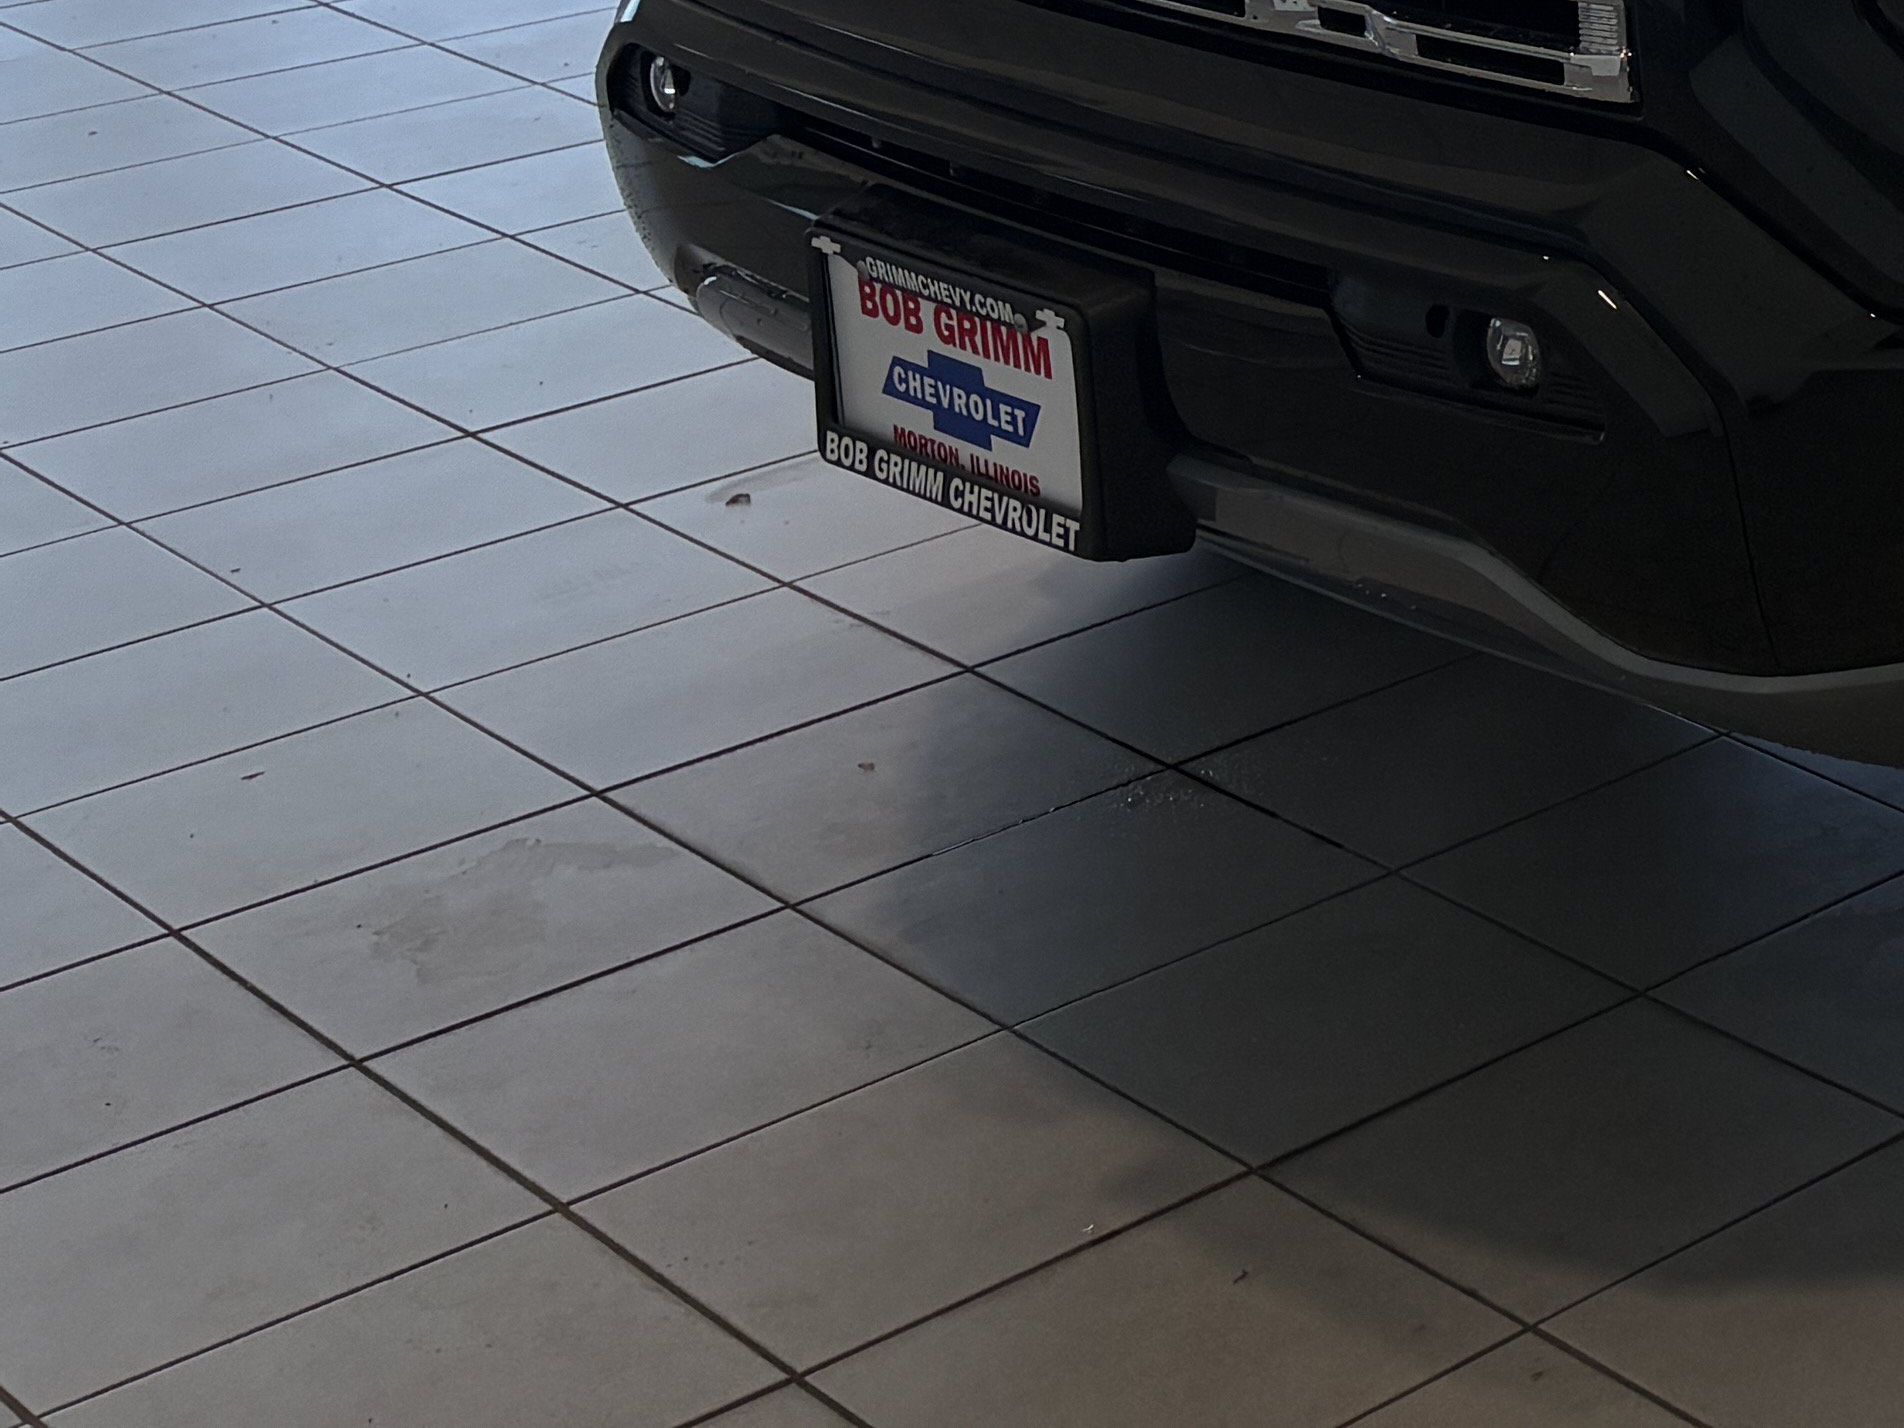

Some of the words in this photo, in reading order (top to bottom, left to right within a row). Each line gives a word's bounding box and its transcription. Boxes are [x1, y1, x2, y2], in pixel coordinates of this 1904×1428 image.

[865, 256, 1015, 325] GRIMMCHEVY.COM
[858, 279, 924, 335] BOB
[934, 304, 1053, 379] GRIMM
[892, 365, 1027, 437] CHEVROLET
[825, 430, 868, 473] BOB
[874, 448, 944, 503] GRIMM
[949, 477, 1080, 552] CHEVROLET
[970, 455, 1041, 497] ILLINOIS
